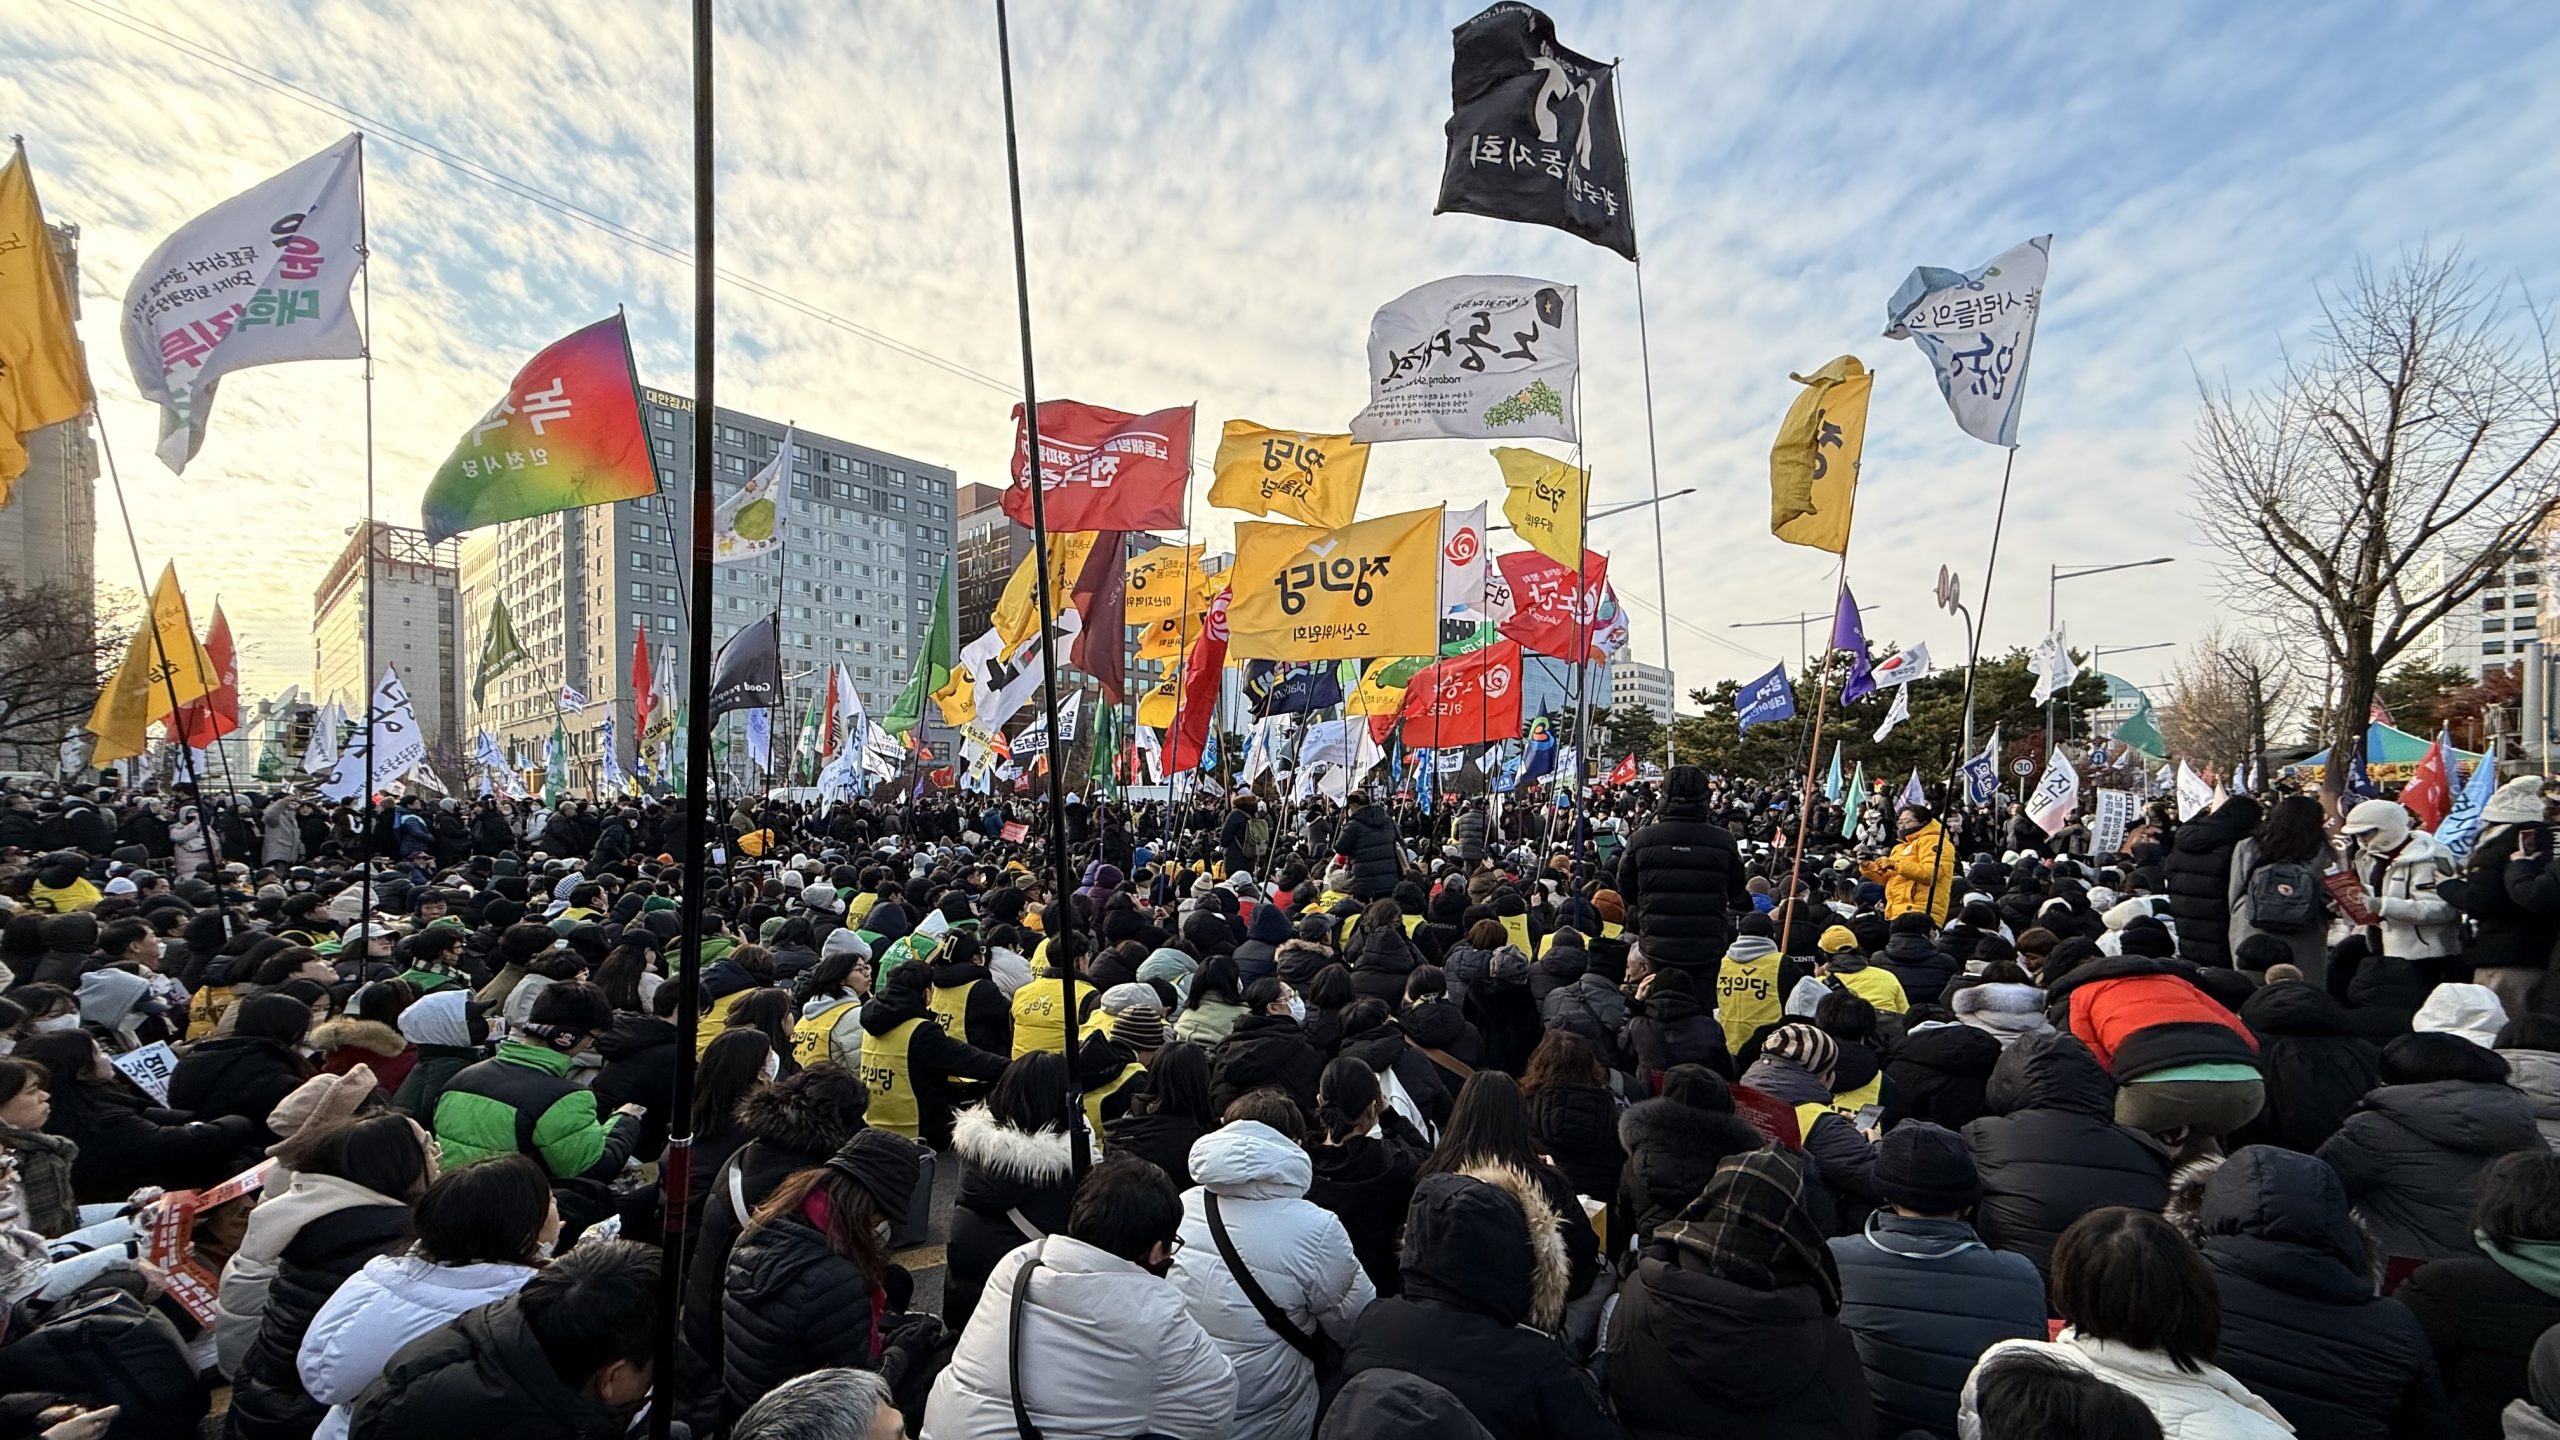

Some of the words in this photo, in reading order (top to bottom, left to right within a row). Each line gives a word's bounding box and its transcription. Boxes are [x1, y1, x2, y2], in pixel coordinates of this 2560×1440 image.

[2016, 762, 2031, 772] 30
[1719, 976, 1770, 1000] 정의당
[1023, 1001, 1053, 1016] 정의당
